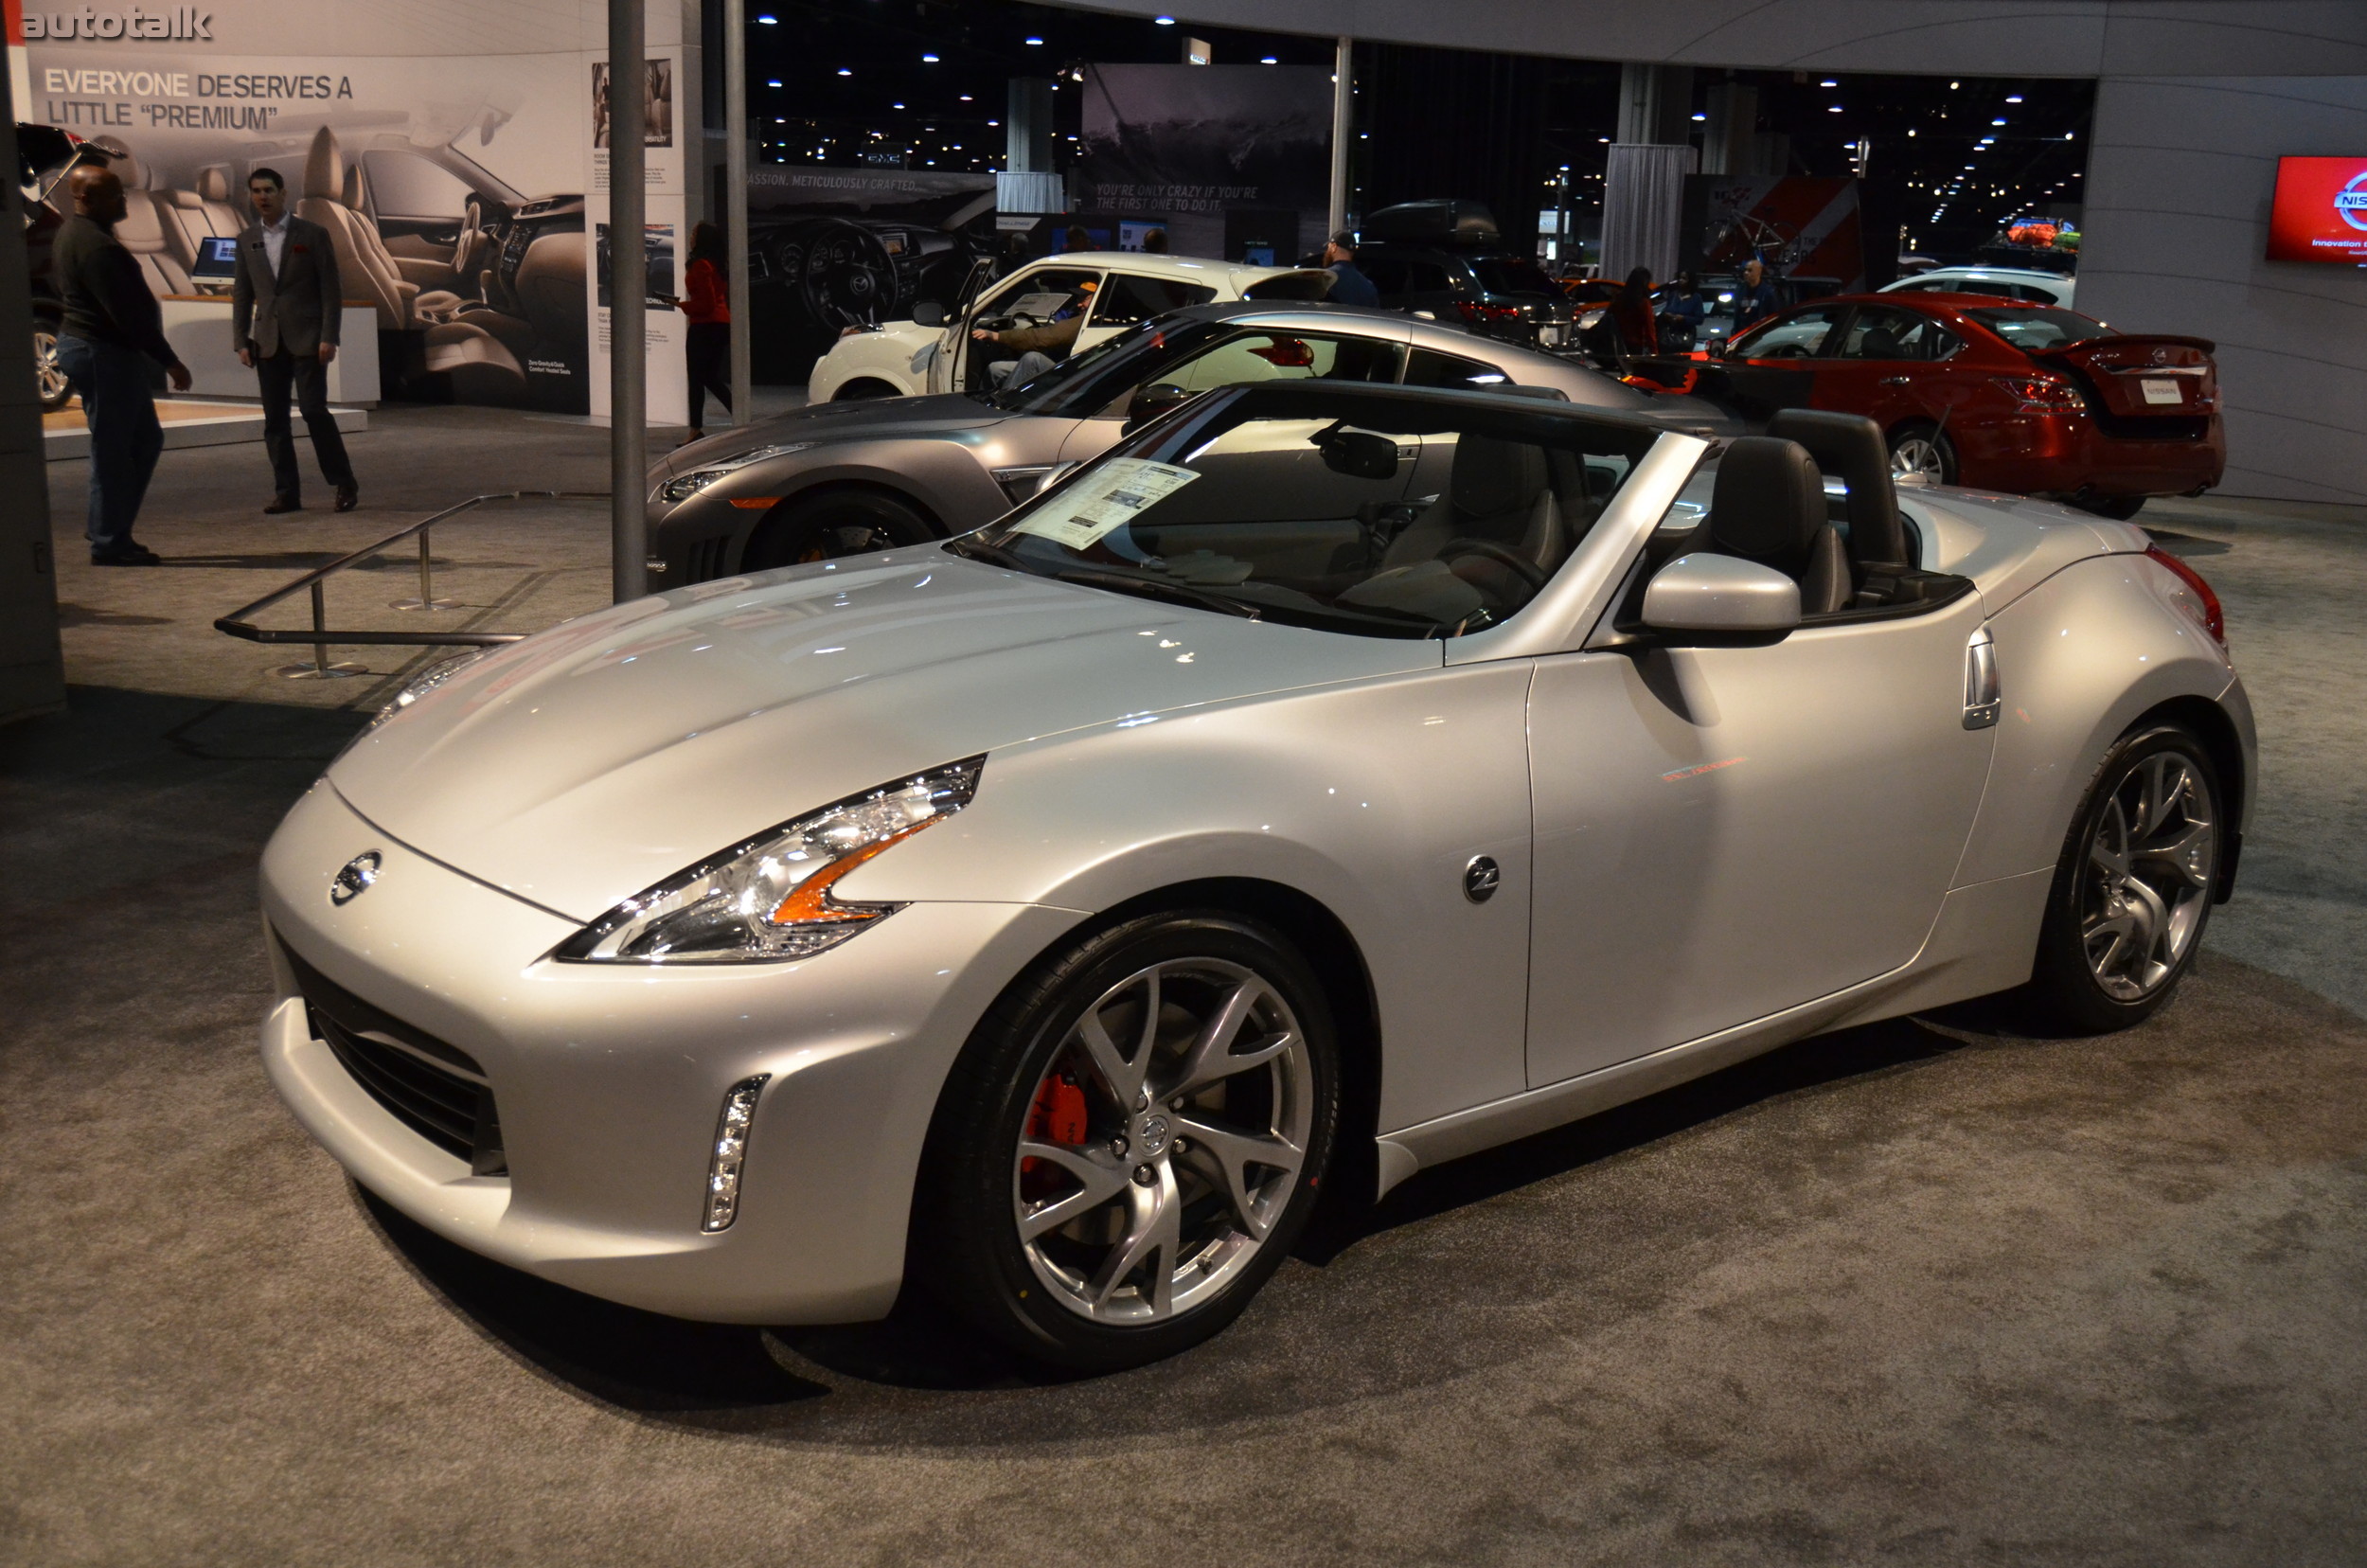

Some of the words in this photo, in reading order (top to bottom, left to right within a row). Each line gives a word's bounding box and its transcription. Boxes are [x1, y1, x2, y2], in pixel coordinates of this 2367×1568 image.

[45, 69, 189, 98] EVERYONE
[197, 74, 331, 99] DESERVES
[336, 76, 353, 99] A
[48, 100, 133, 126] LITTLE
[867, 153, 900, 164] GMC
[745, 173, 789, 187] ASSION.
[792, 175, 869, 189] METICULOUSLY
[1096, 184, 1135, 196] YOU'RE
[1137, 185, 1166, 197] ONLY
[1166, 186, 1201, 198] CRAZY
[1204, 187, 1216, 198] IF
[1218, 187, 1258, 199] YOU'RE
[1096, 197, 1115, 209] THE
[1118, 198, 1148, 210] FIRST
[1150, 199, 1173, 210] ONE
[1175, 199, 1189, 211] TO
[1191, 200, 1207, 211] DO
[1209, 200, 1221, 212] IT.
[2342, 196, 2367, 205] NIS
